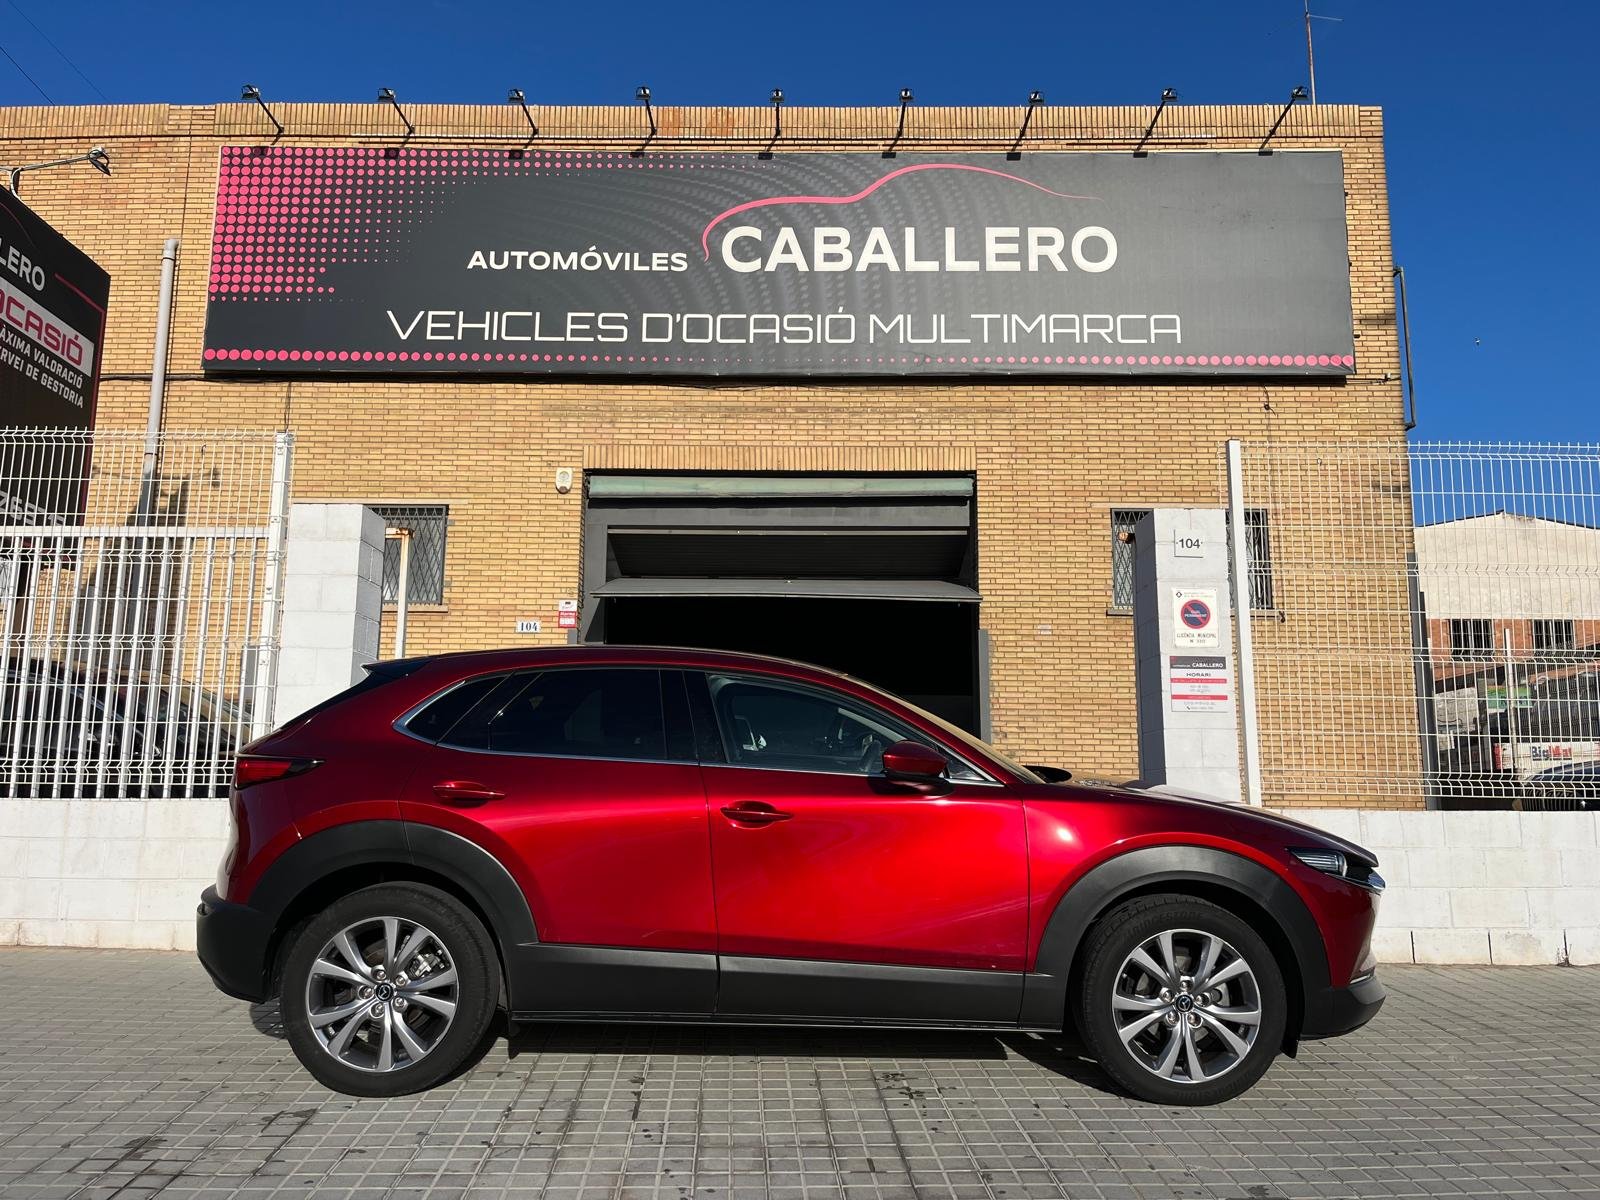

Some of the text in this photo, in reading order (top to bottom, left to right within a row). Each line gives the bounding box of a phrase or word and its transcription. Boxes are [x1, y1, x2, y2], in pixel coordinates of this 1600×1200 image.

[467, 226, 1119, 274] AUTOMÓVILES CABALLERO
[386, 306, 1182, 344] VEHICLES D'OCASIÓ MULTIMARCA
[0, 346, 84, 408] RVEI DE GESTORIA
[33, 348, 83, 389] VALORACIÓ
[1179, 538, 1201, 549] 104
[520, 622, 538, 631] 104
